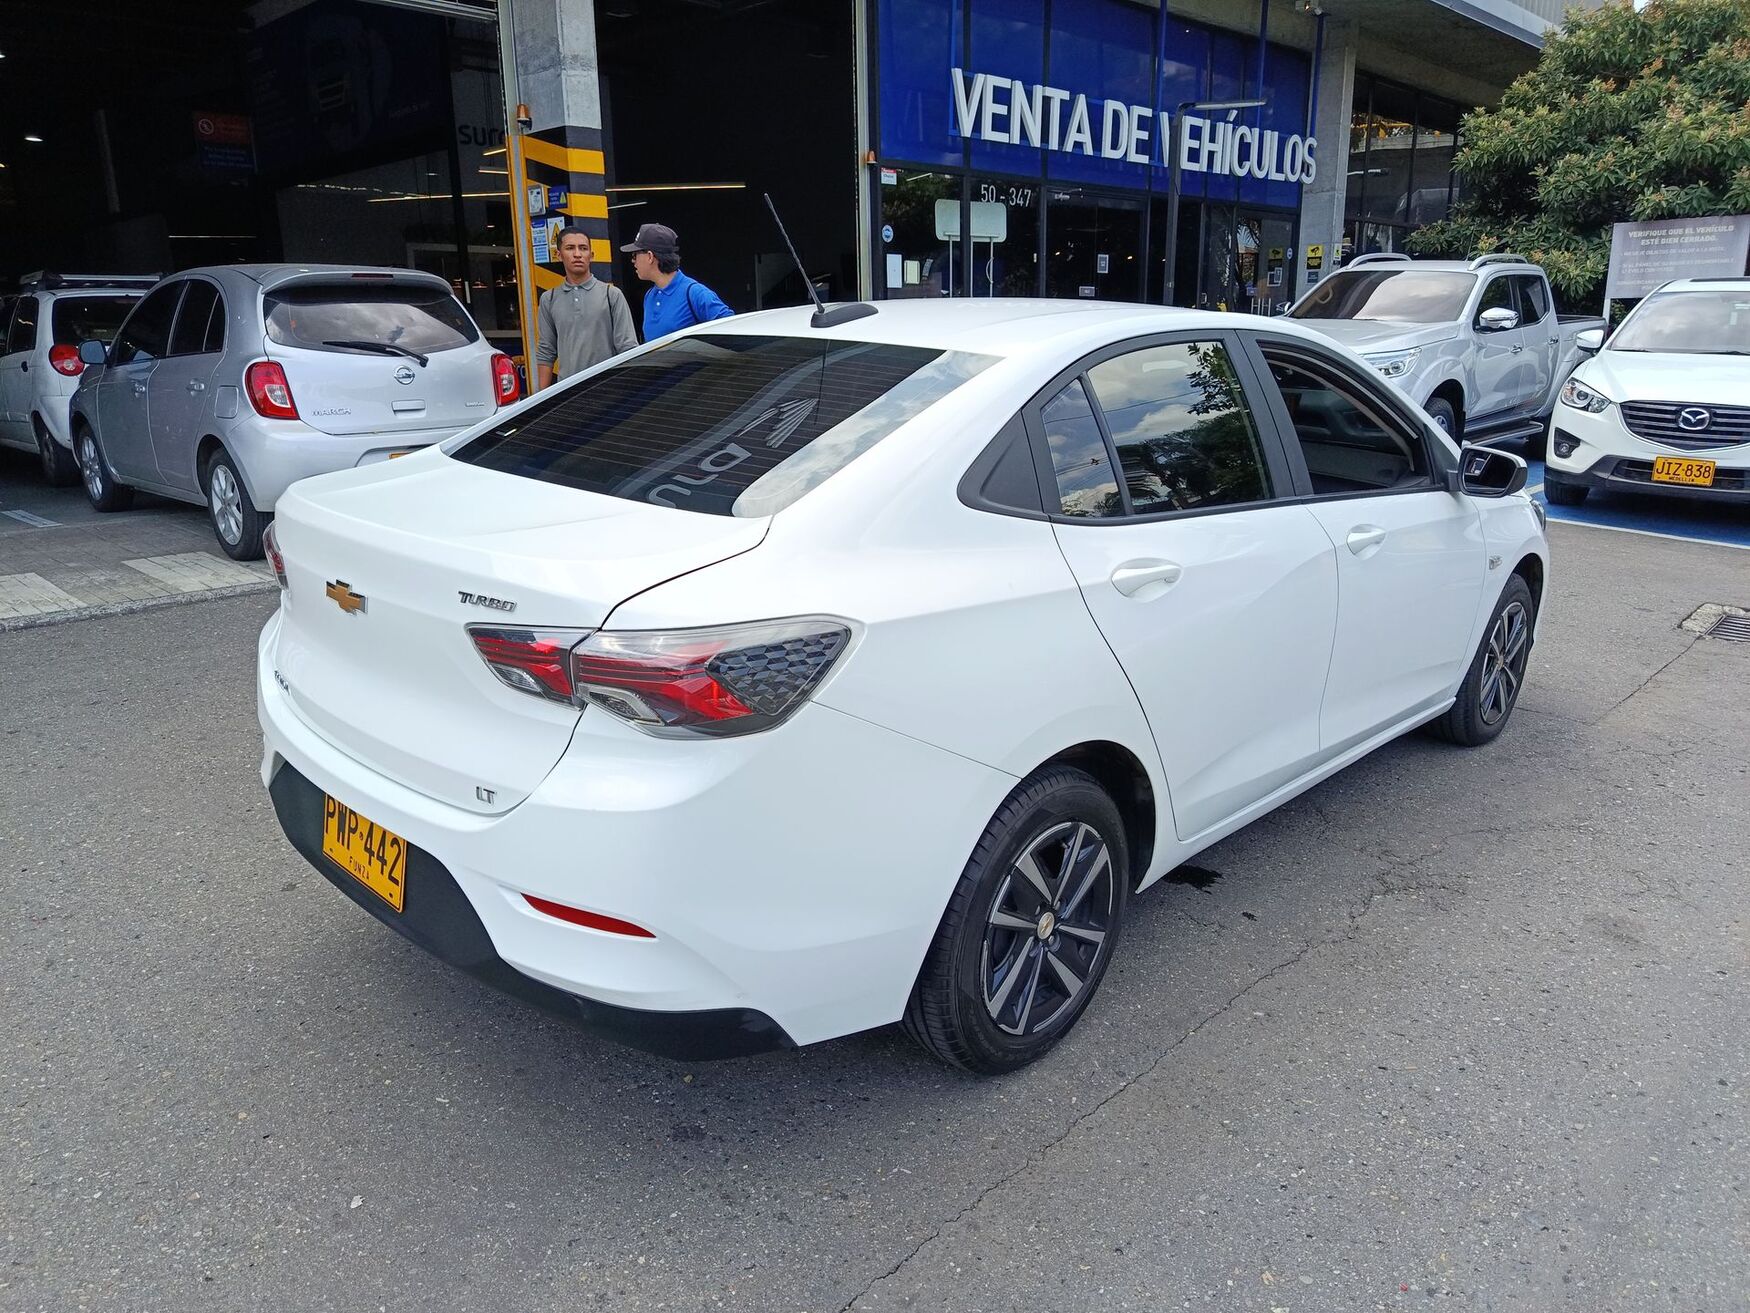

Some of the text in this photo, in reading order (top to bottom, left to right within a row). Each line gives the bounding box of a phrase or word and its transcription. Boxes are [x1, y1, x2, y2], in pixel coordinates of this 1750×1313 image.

[951, 67, 1093, 157] VENTA
[1100, 98, 1153, 164] DE
[981, 184, 996, 203] 50
[1009, 187, 1032, 207] 347
[1668, 228, 1684, 236] QUE
[458, 591, 517, 612] TURBO
[476, 786, 497, 805] LT
[348, 855, 370, 880] FUNZA
